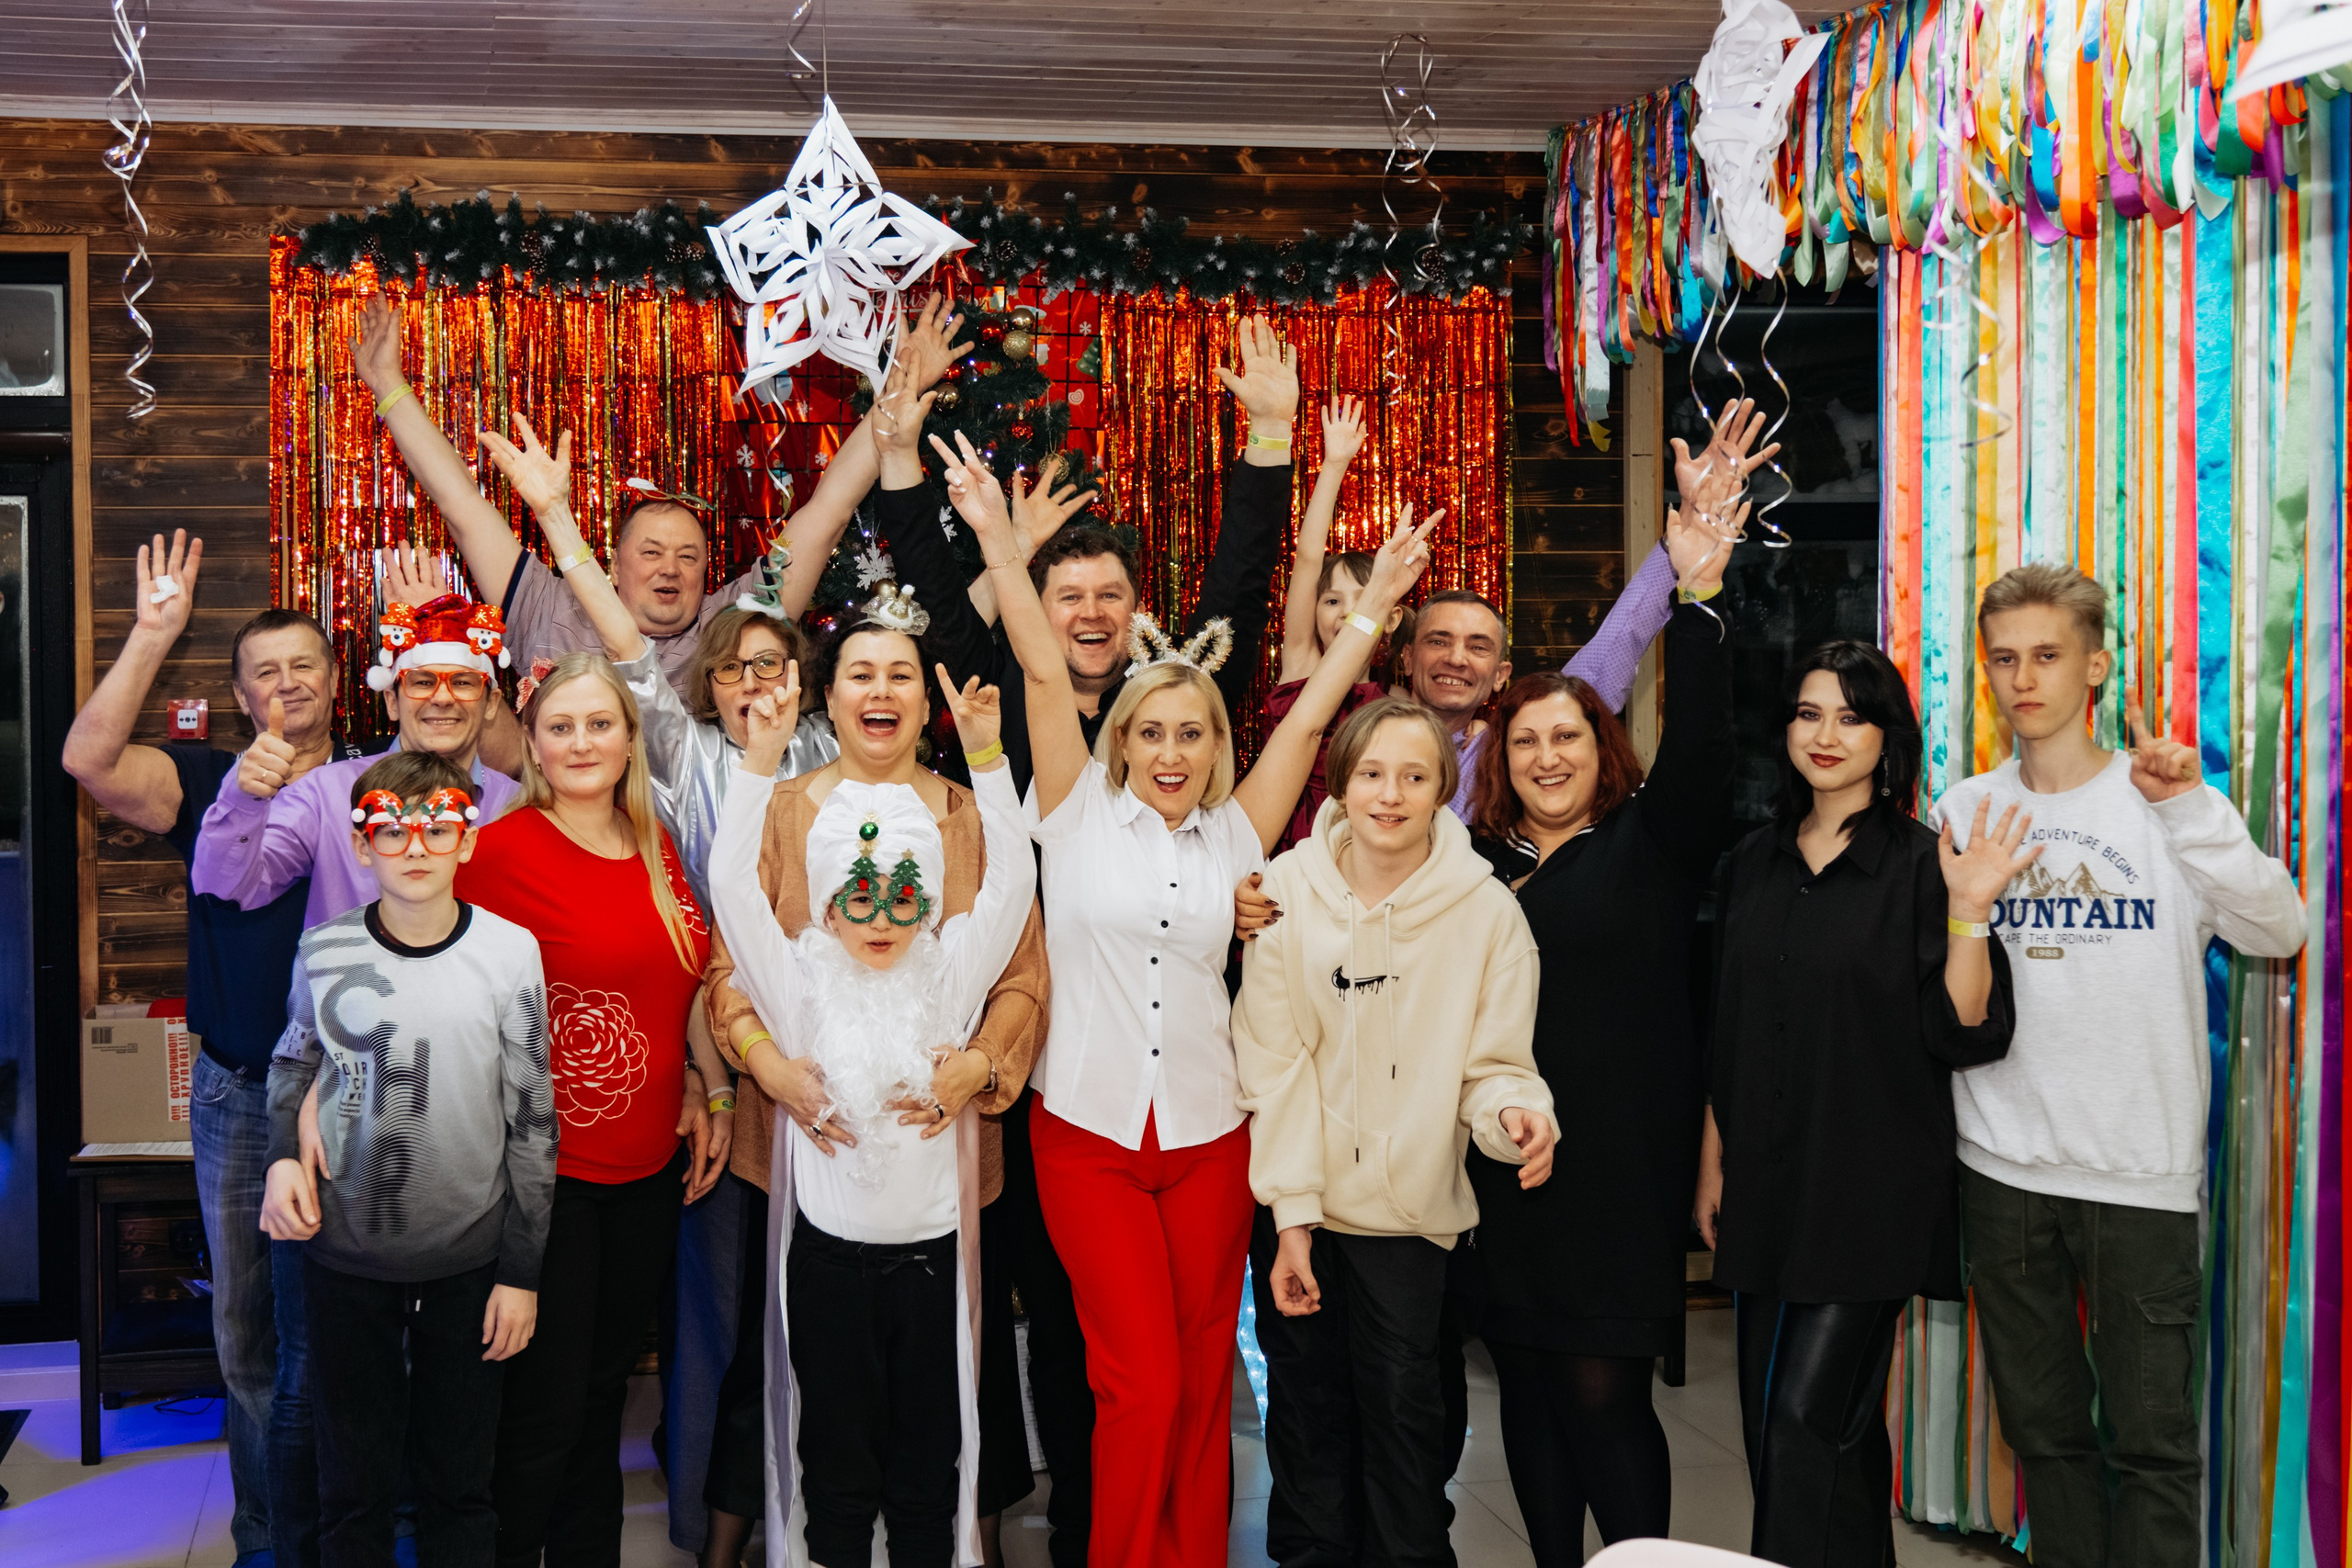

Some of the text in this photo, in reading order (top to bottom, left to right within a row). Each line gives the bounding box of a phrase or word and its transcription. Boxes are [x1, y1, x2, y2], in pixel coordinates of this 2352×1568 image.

[2031, 829, 2140, 885] ADVENTURE BEGINS
[1990, 897, 2155, 930] OUNTAIN
[2030, 933, 2050, 944] THE
[2055, 933, 2113, 945] ORDINARY
[2031, 948, 2060, 958] 1988
[167, 1032, 181, 1099] ОСТОРОЖНО!!!
[178, 1032, 191, 1098] ХРУПКОЕ!!!
